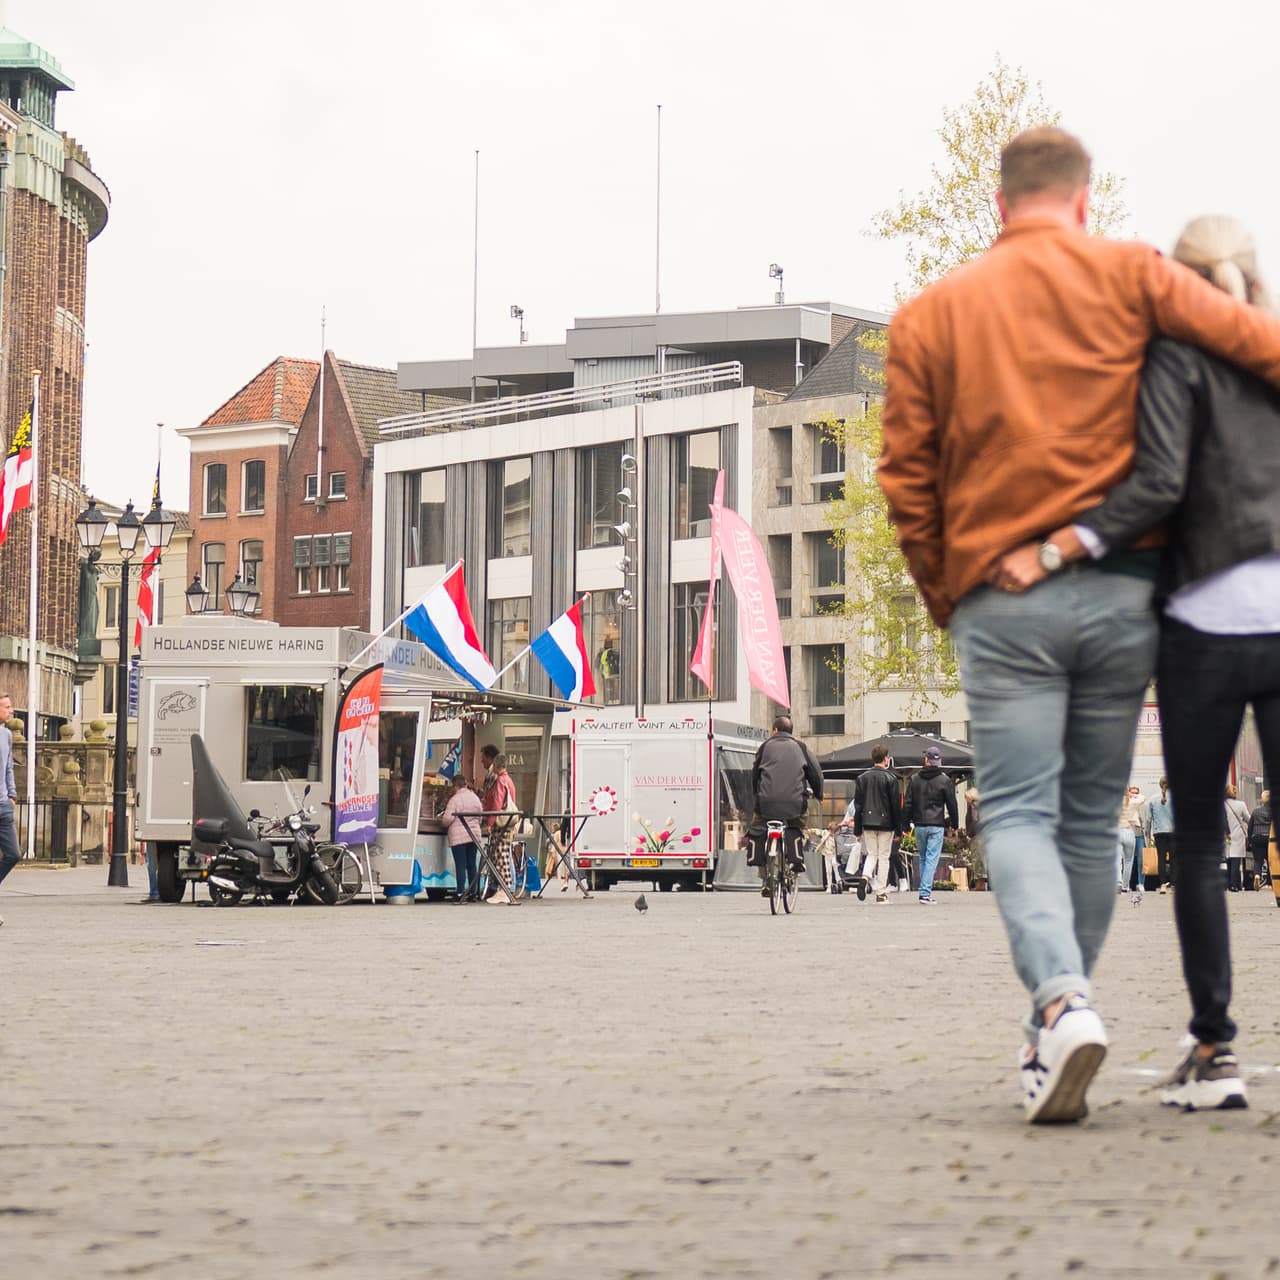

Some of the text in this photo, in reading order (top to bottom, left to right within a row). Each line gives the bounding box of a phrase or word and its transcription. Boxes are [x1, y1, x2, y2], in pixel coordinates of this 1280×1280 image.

[154, 637, 324, 651] HOLLANDSE NIEUWE HARING
[580, 721, 707, 730] KWALITEIT WINT ALTIJD!
[634, 775, 703, 785] VAN DER VEER
